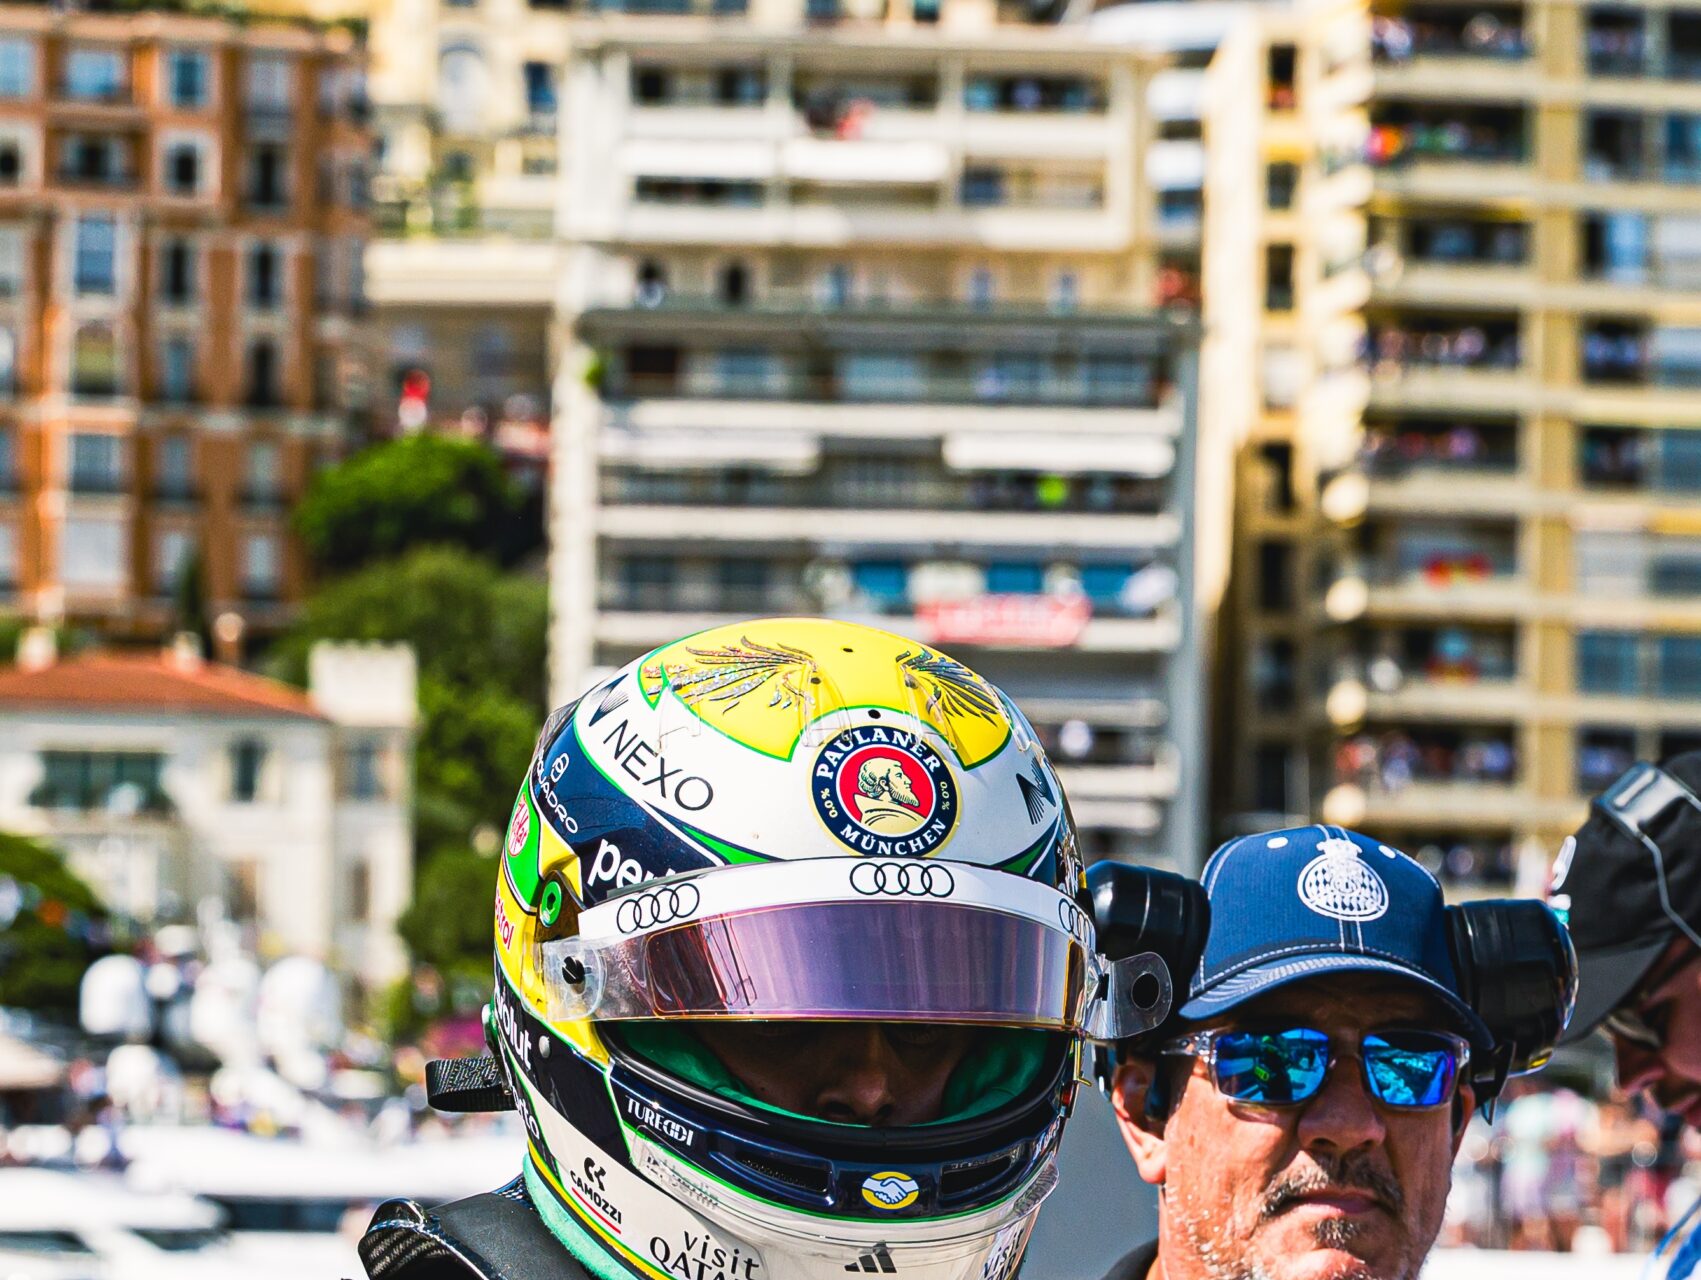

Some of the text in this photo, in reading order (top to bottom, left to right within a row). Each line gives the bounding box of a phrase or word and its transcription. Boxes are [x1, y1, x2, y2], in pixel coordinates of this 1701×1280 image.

[603, 719, 714, 811] NEXO
[816, 727, 941, 780] PAULANER
[839, 818, 947, 855] MÜNCHEN
[569, 1169, 622, 1225] CAMOZZI
